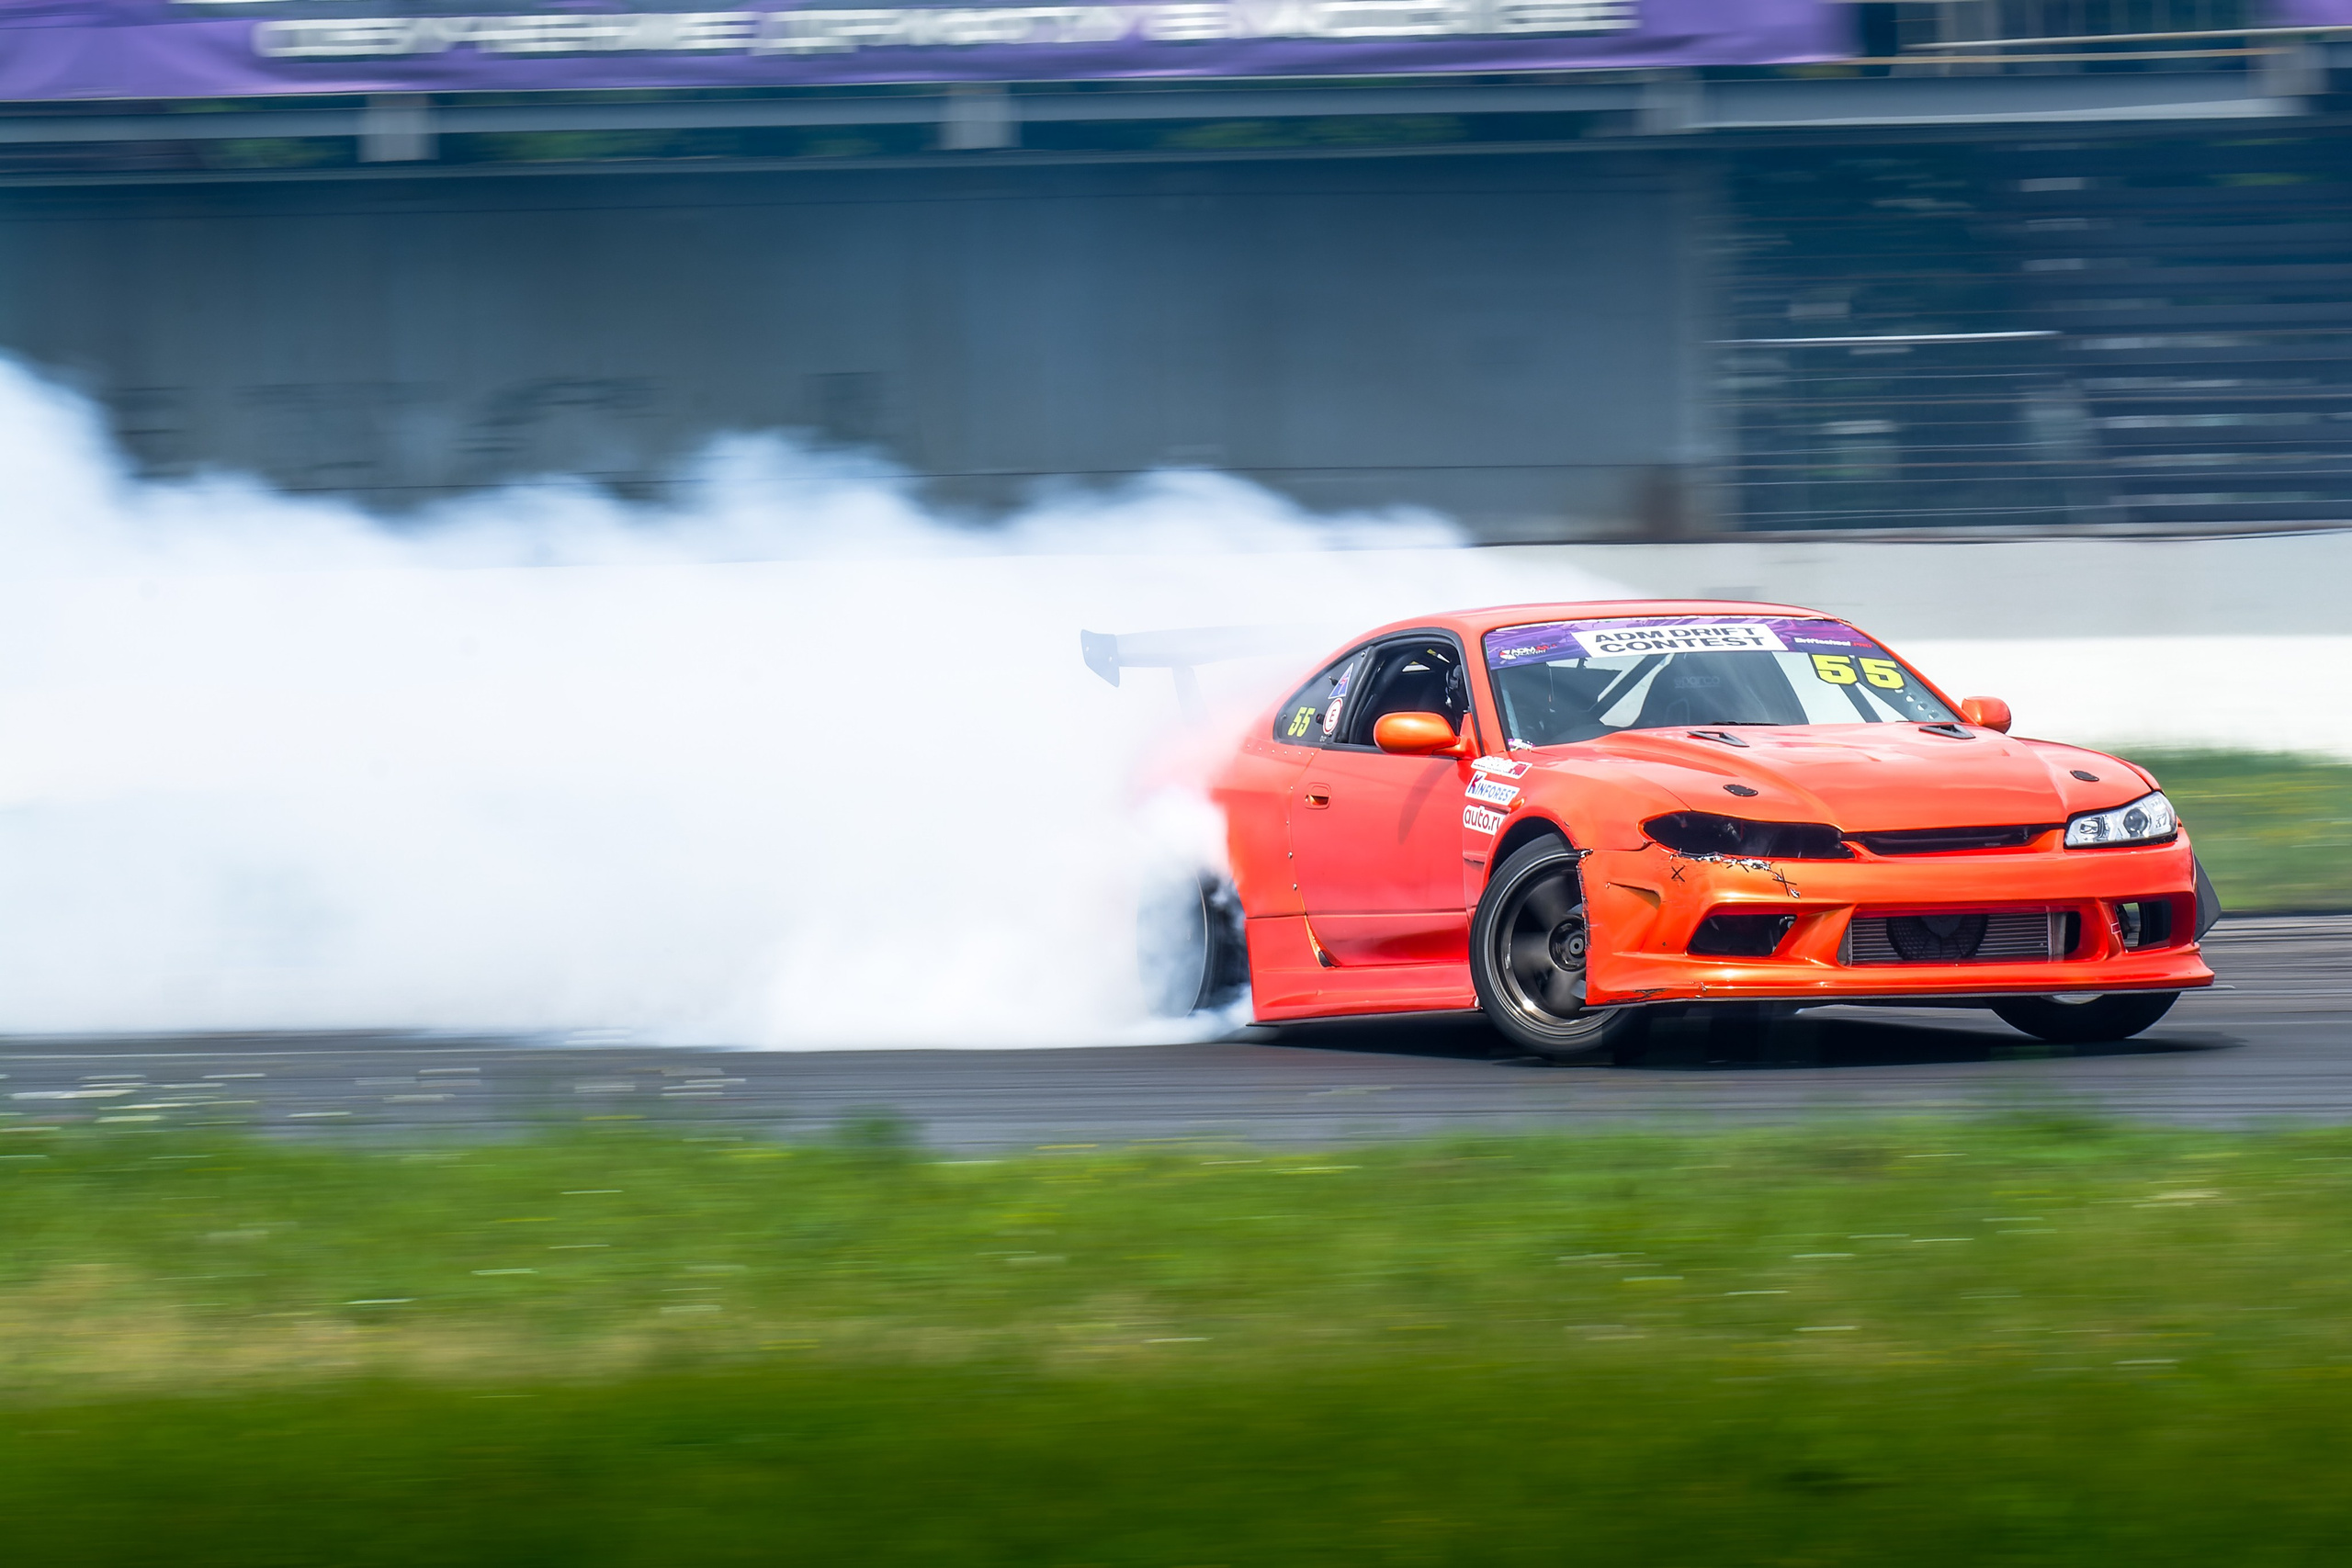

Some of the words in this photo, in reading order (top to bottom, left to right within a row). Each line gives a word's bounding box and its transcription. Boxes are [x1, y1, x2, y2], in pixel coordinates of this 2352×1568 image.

[1595, 630, 1667, 643] ADM
[1668, 626, 1756, 637] DRIFT
[1600, 637, 1764, 653] CONTEST
[1811, 654, 1905, 690] 55
[1287, 706, 1316, 738] 55
[1329, 708, 1337, 723] E
